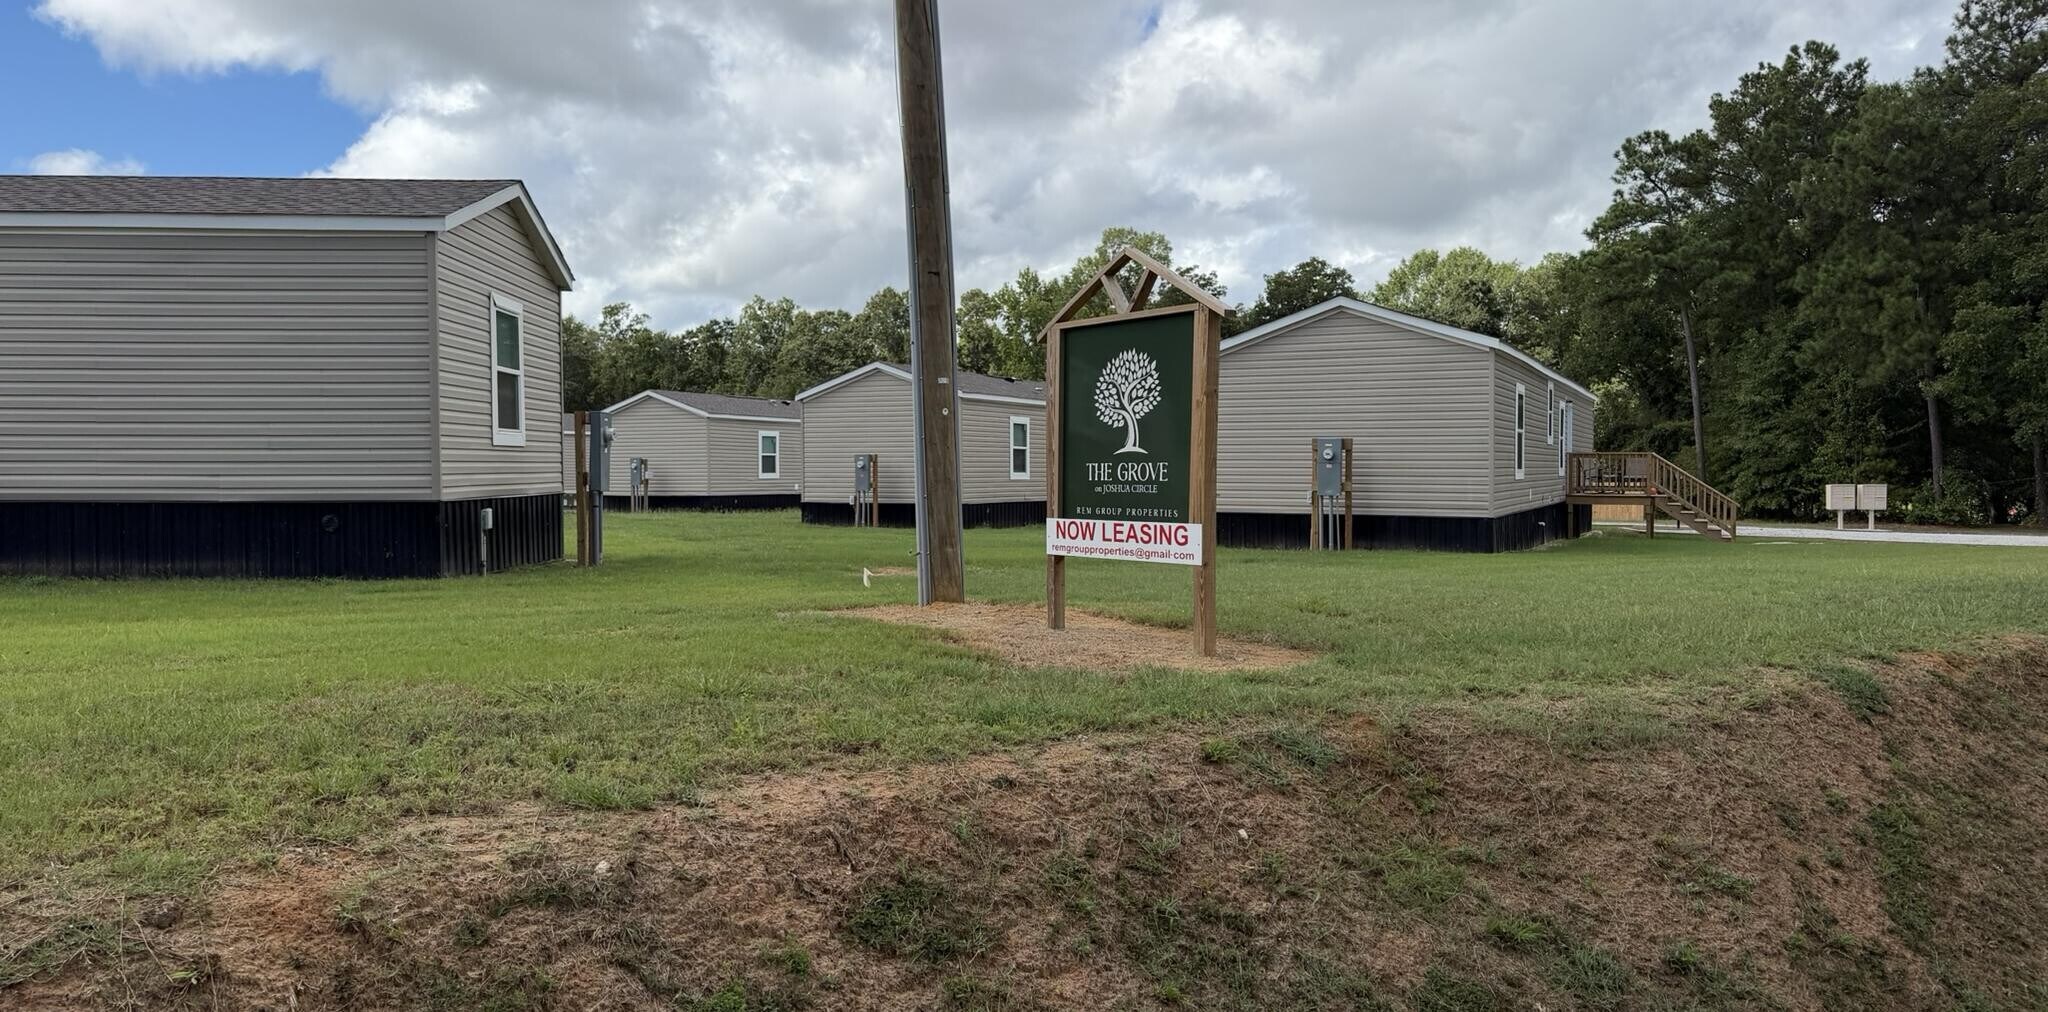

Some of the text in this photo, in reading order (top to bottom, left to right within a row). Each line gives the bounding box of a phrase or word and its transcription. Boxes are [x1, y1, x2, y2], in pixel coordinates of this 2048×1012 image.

[1086, 461, 1168, 482] THE GROVE
[1102, 484, 1130, 494] JOSHUA
[1131, 484, 1158, 493] CIRCLE
[1076, 506, 1178, 518] REM GROUP PROPERTIES
[1056, 520, 1188, 546] NOW LEASING
